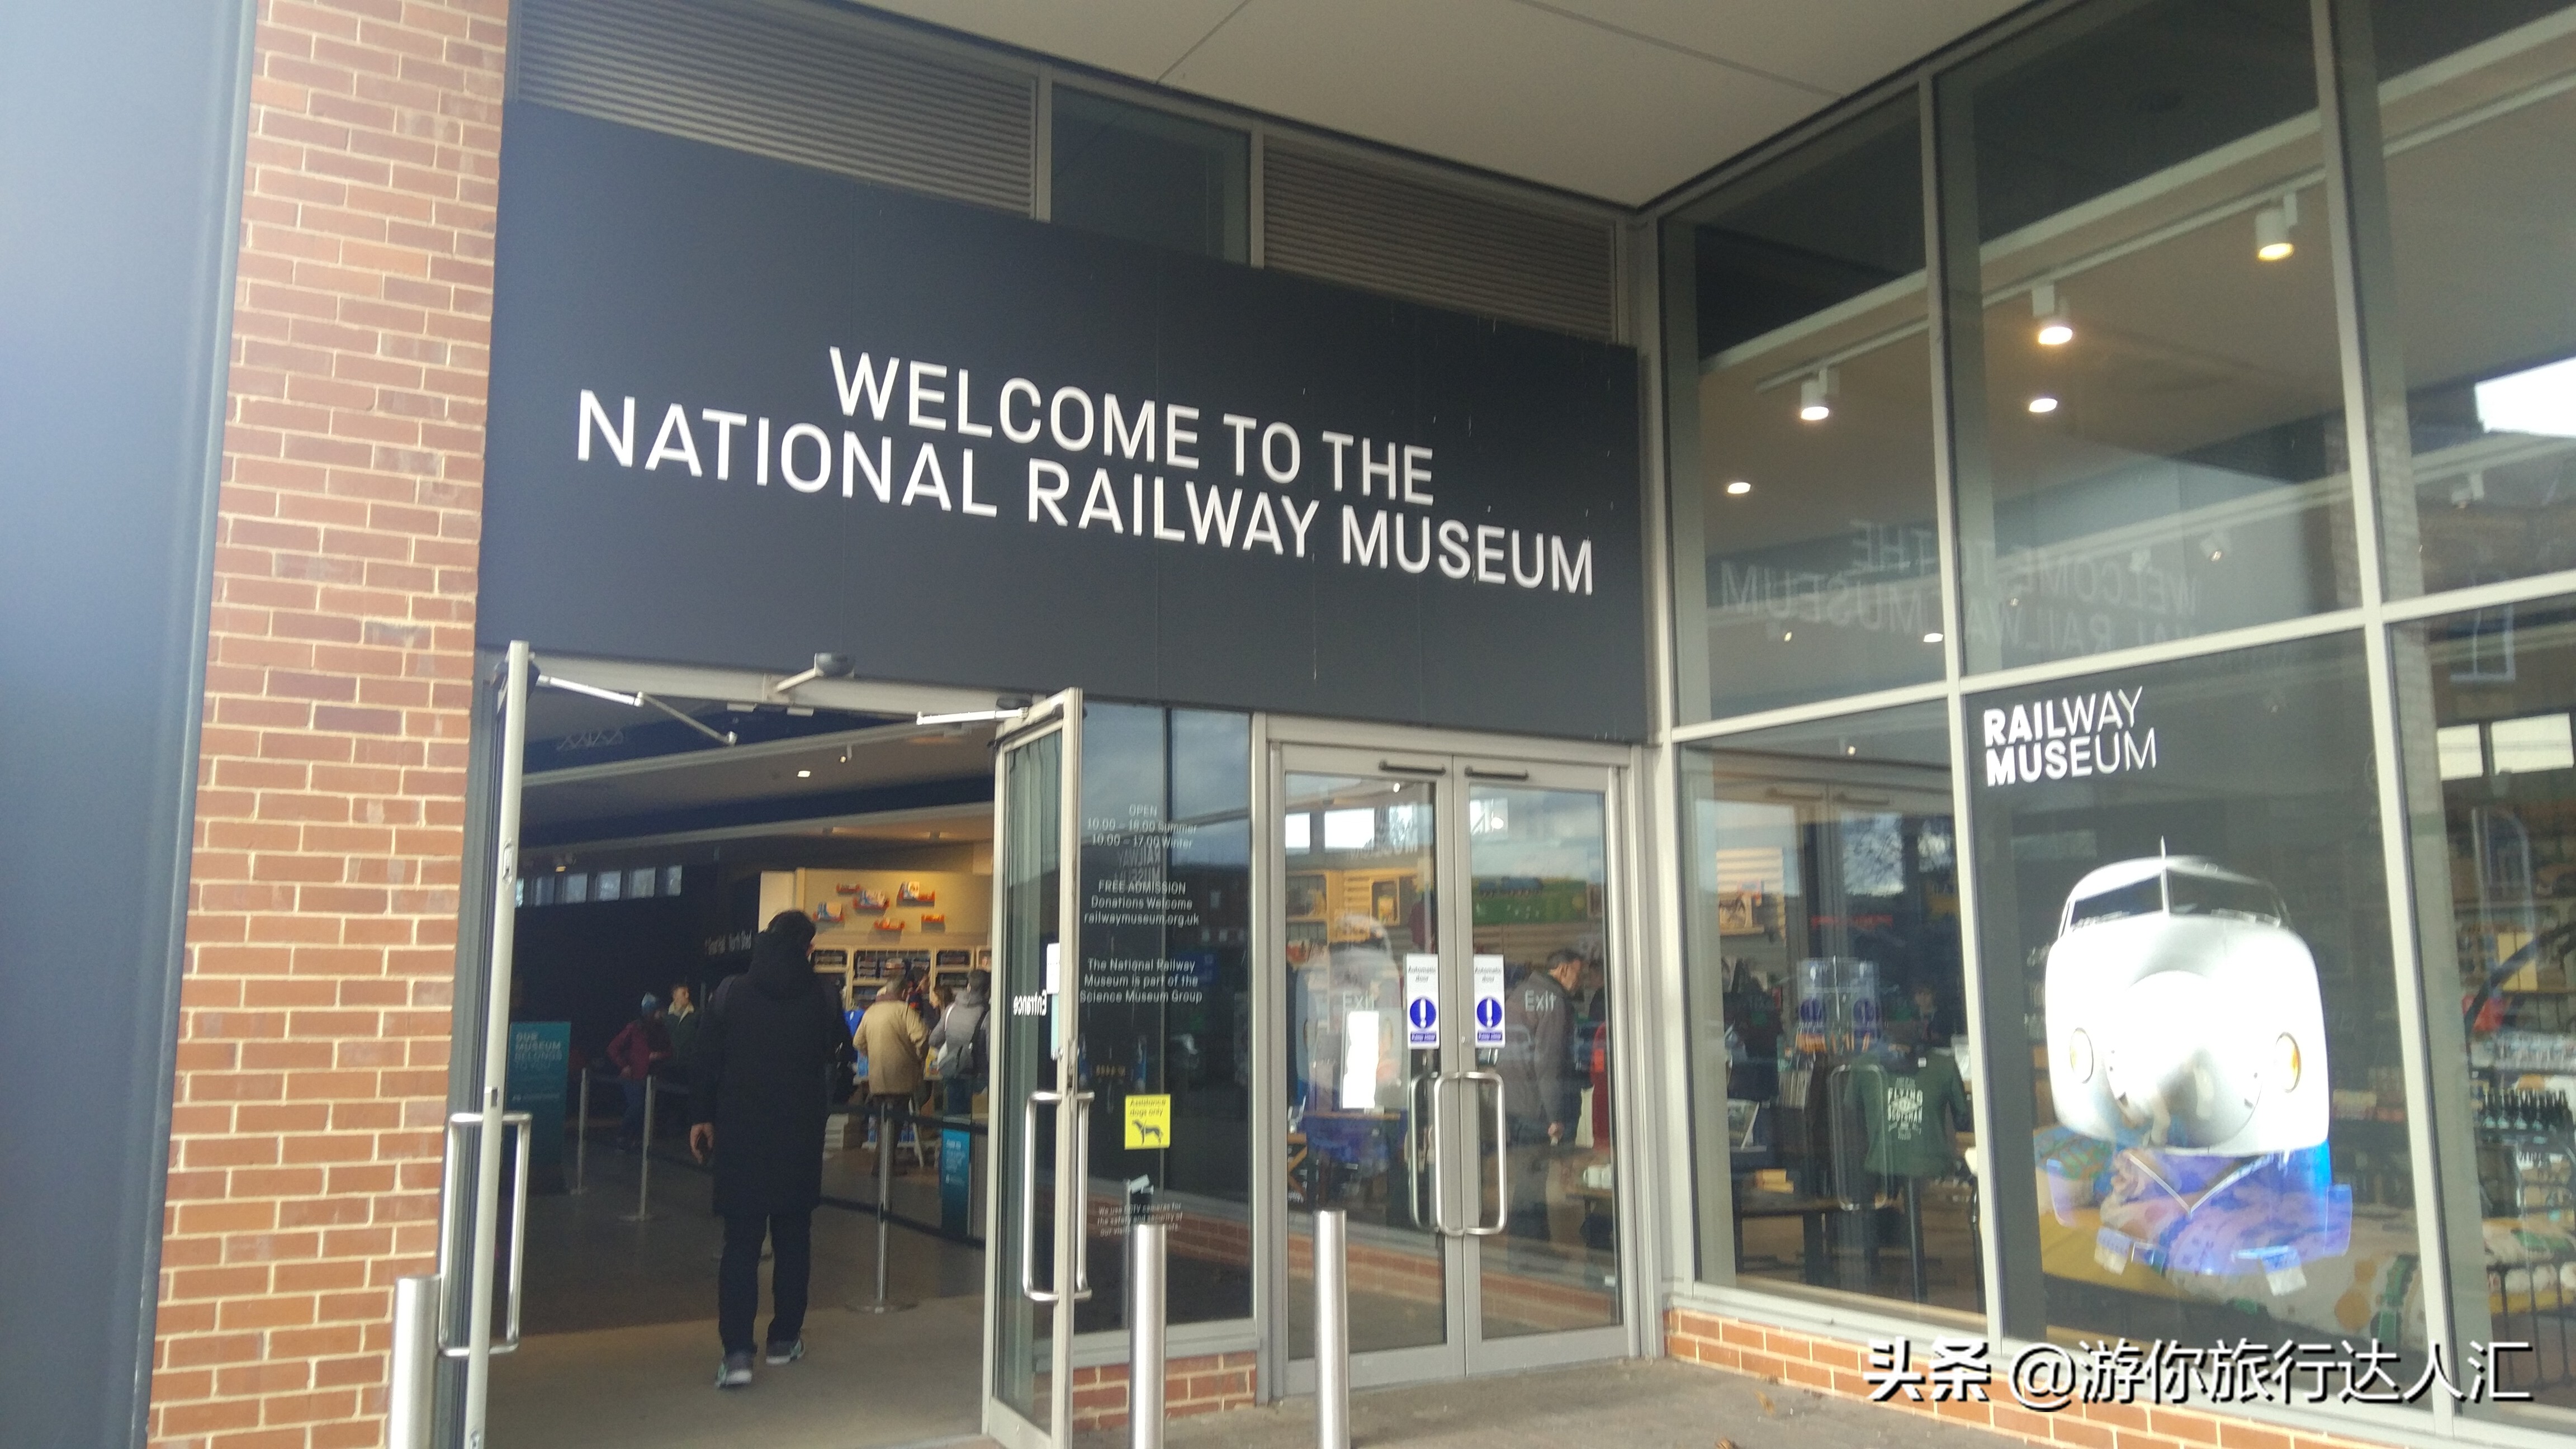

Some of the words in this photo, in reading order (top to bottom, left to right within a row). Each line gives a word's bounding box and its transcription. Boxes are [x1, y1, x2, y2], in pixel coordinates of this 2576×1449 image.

[829, 345, 1200, 470] WELCOME
[1223, 413, 1301, 484] TO
[1322, 430, 1434, 506] THE
[577, 388, 998, 518] NATIONAL
[1028, 457, 1320, 558] RAILWAY
[1342, 504, 1593, 596] MUSEUM
[1983, 685, 2143, 748] RAILWAY
[1985, 727, 2157, 787] MUSEUM
[1129, 803, 1157, 818] OPEN
[1162, 836, 1194, 849] Winter
[1098, 879, 1125, 893] FREE
[1128, 880, 1186, 896] ADMISSION
[1091, 894, 1144, 910] Donations
[1147, 895, 1193, 911] Welcome
[1084, 910, 1200, 929] railwaymuseum.org.uk
[1087, 958, 1107, 972] The
[1110, 957, 1154, 972] National
[1157, 958, 1196, 975] Railway
[1084, 973, 1129, 988] Museum
[1131, 973, 1140, 988] is
[1143, 974, 1165, 989] part
[1167, 973, 1179, 988] of
[1181, 974, 1199, 988] the
[1079, 989, 1123, 1004] Science
[1125, 989, 1169, 1003] Museum
[1172, 989, 1202, 1005] Group
[1524, 989, 1557, 1012] Exit
[1888, 1087, 1924, 1106] FLYING
[1130, 1109, 1147, 1117] dogs
[1149, 1107, 1163, 1117] only
